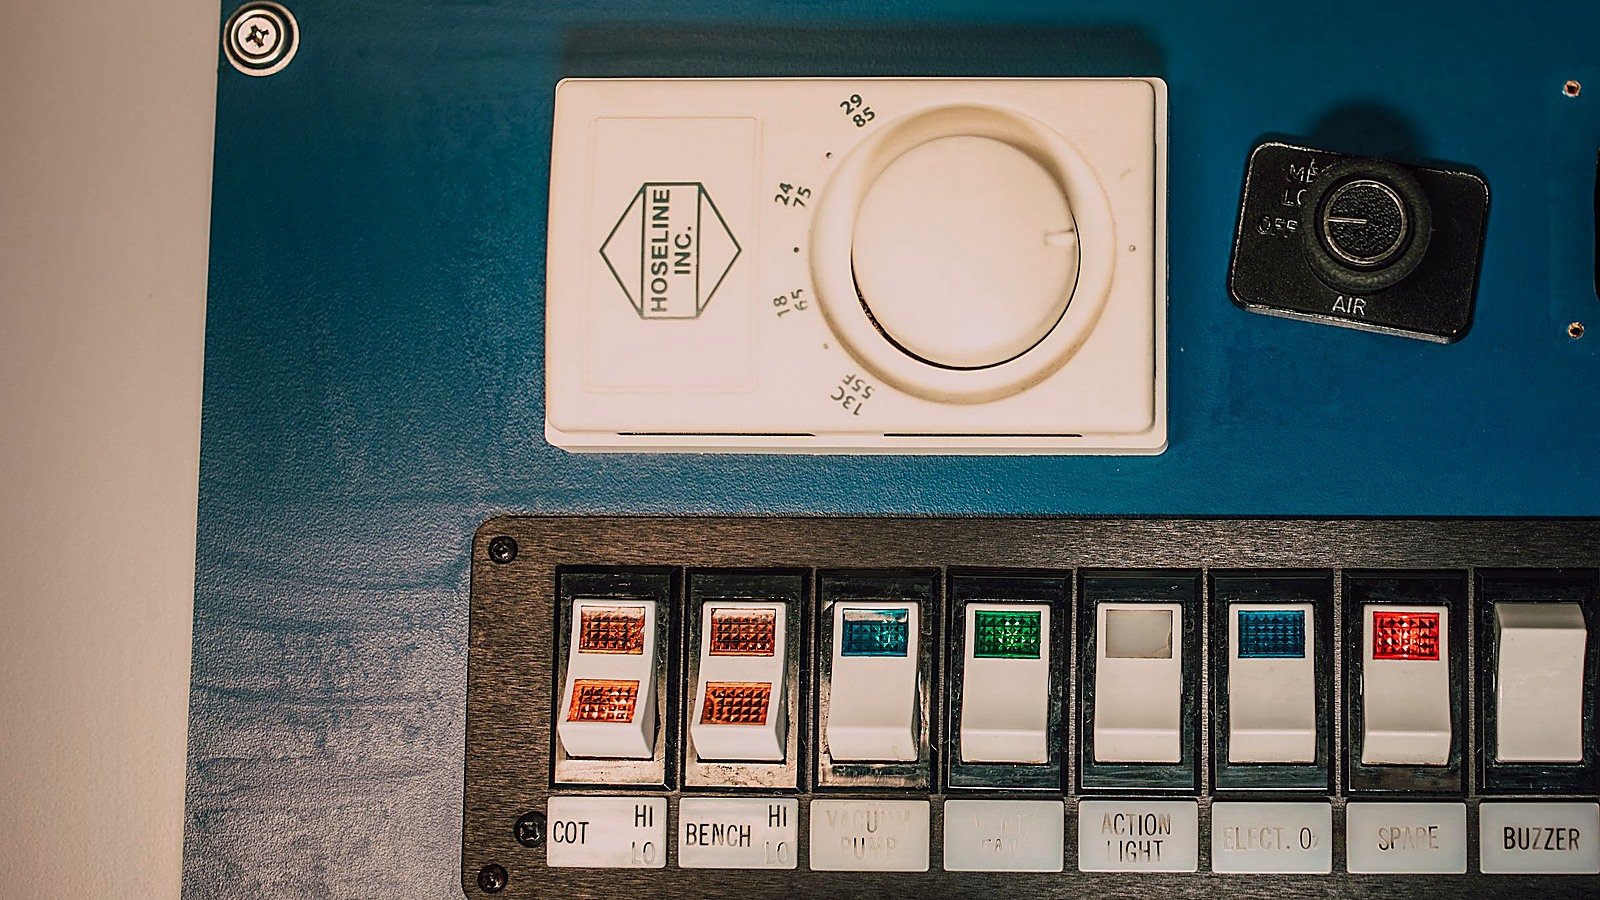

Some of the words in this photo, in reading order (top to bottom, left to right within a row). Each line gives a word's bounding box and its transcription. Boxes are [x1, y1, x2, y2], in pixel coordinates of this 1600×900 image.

[840, 94, 862, 115] 29
[853, 107, 875, 127] 85
[775, 182, 793, 205] 24
[793, 186, 811, 208] 75
[1258, 216, 1298, 238] OFF
[650, 188, 670, 313] HOSELINE
[673, 226, 693, 275] INC.
[773, 295, 790, 317] 18
[791, 288, 808, 311] 65
[1332, 295, 1367, 316] AIR
[842, 374, 876, 399] 55F
[830, 386, 862, 416] 13C
[634, 804, 653, 828] HI
[768, 804, 787, 828] HI
[1101, 813, 1171, 836] ACTION
[553, 820, 589, 845] COT
[686, 823, 751, 848] BENCH
[1378, 826, 1439, 851] SPARE
[1504, 827, 1580, 850] BUZZER
[631, 841, 656, 865] LO
[764, 841, 790, 865] LO
